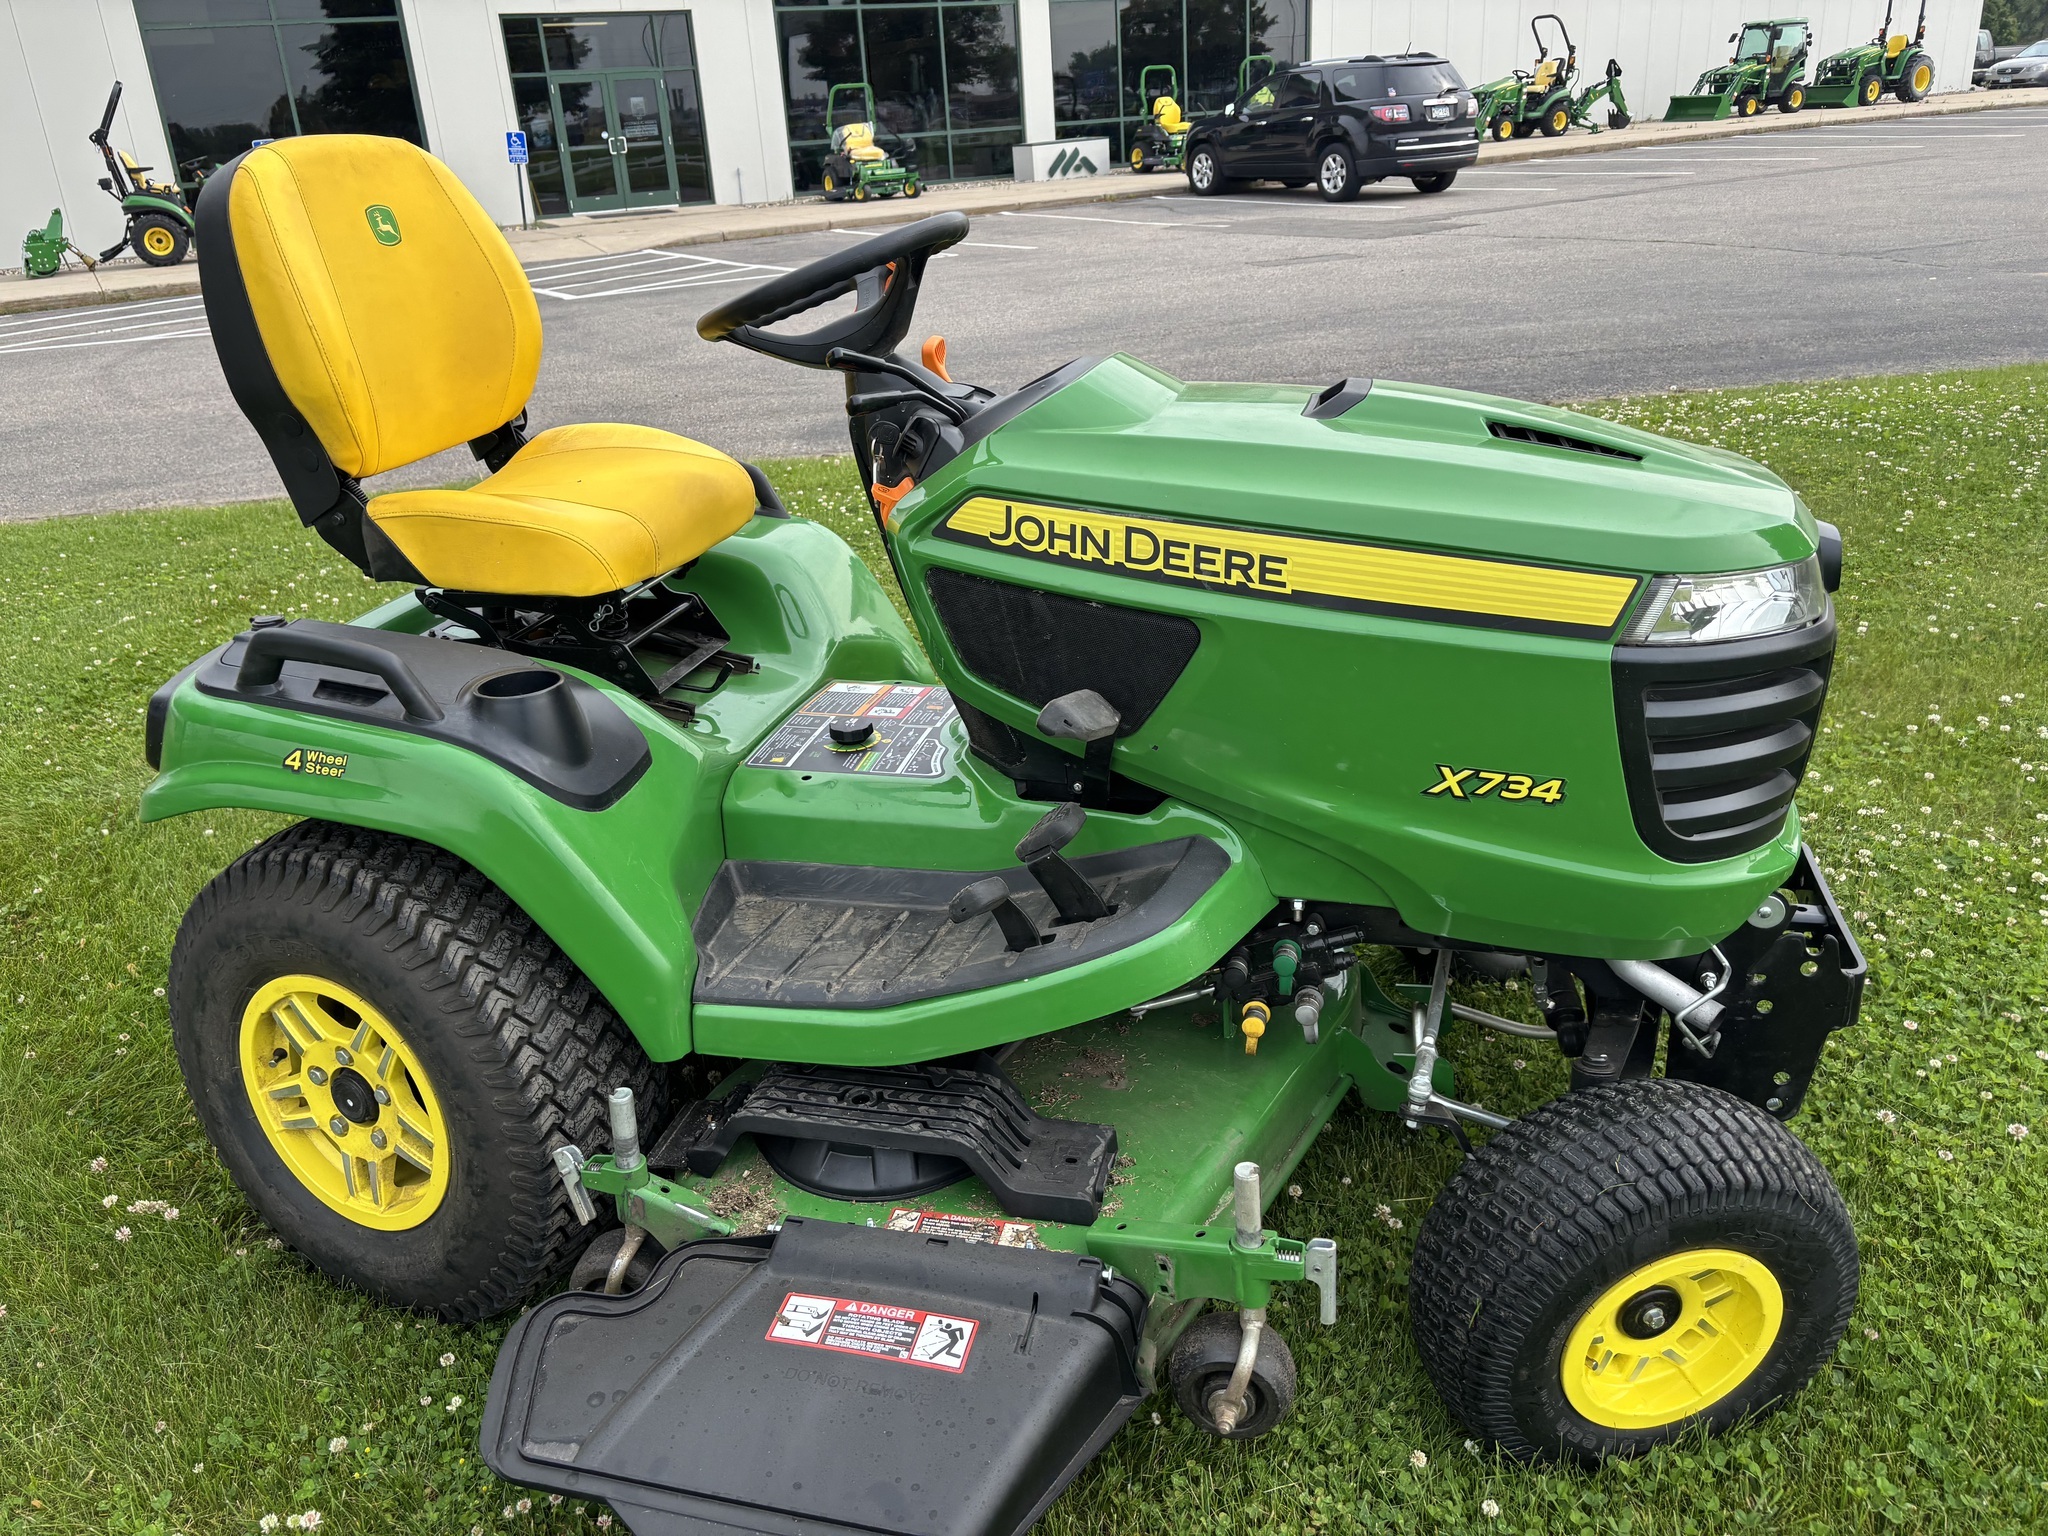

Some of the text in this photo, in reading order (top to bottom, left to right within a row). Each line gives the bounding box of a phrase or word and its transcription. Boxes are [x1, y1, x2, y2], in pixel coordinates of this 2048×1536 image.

[989, 505, 1289, 590] JOHN DEERE
[284, 749, 348, 771] 4 Wheel
[304, 761, 345, 778] Steer
[1424, 765, 1564, 804] X734
[848, 1313, 882, 1321] ROTATING
[860, 1304, 915, 1320] DANGER
[784, 1367, 811, 1382] DO
